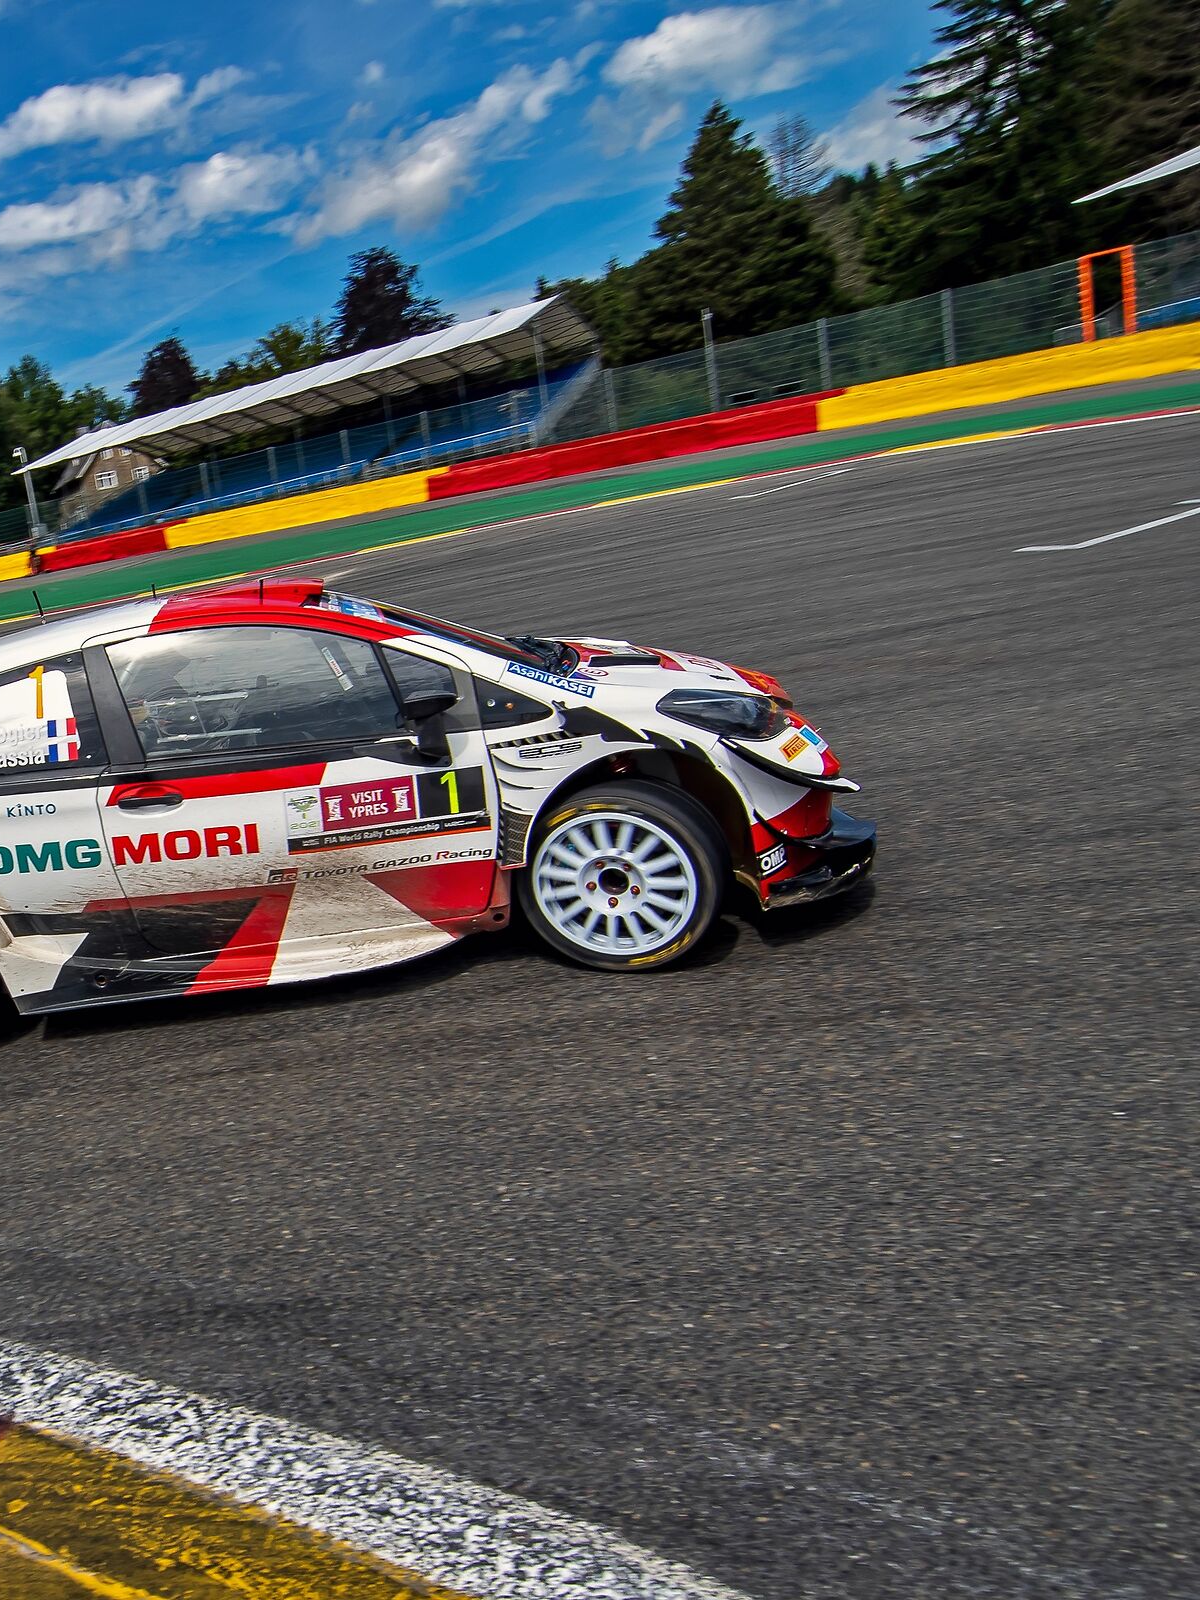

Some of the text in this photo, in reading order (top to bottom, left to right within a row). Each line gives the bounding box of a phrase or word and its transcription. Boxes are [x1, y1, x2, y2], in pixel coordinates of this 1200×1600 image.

[28, 665, 45, 719] 1
[350, 789, 384, 805] VISIT
[440, 771, 460, 814] 1
[348, 802, 389, 819] YPRES
[111, 822, 260, 866] MORI
[324, 836, 338, 845] FIA
[339, 832, 362, 842] World
[363, 830, 384, 840] Rally
[384, 822, 440, 837] Championship
[302, 864, 368, 879] TOYOTA
[372, 854, 432, 870] GAZOO
[435, 847, 493, 860] Racing
[761, 847, 786, 871] OMP
